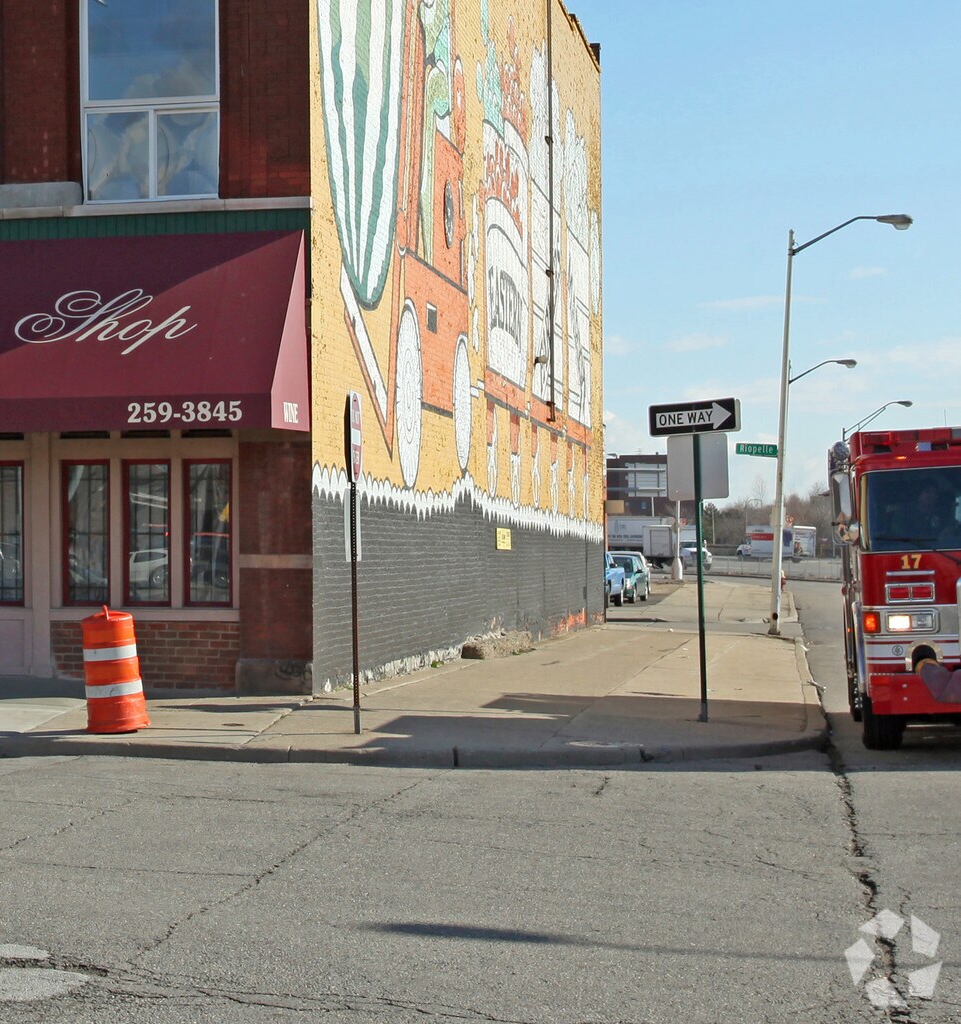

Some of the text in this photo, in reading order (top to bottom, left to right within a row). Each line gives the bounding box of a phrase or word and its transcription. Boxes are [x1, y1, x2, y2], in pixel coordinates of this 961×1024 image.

[488, 265, 522, 354] EASTERN
[14, 288, 198, 355] Shop
[127, 400, 243, 424] 259-3845
[283, 401, 299, 424] WINE
[659, 410, 713, 427] ONE WAY
[739, 443, 774, 456] Riopelle
[900, 554, 922, 570] 17
